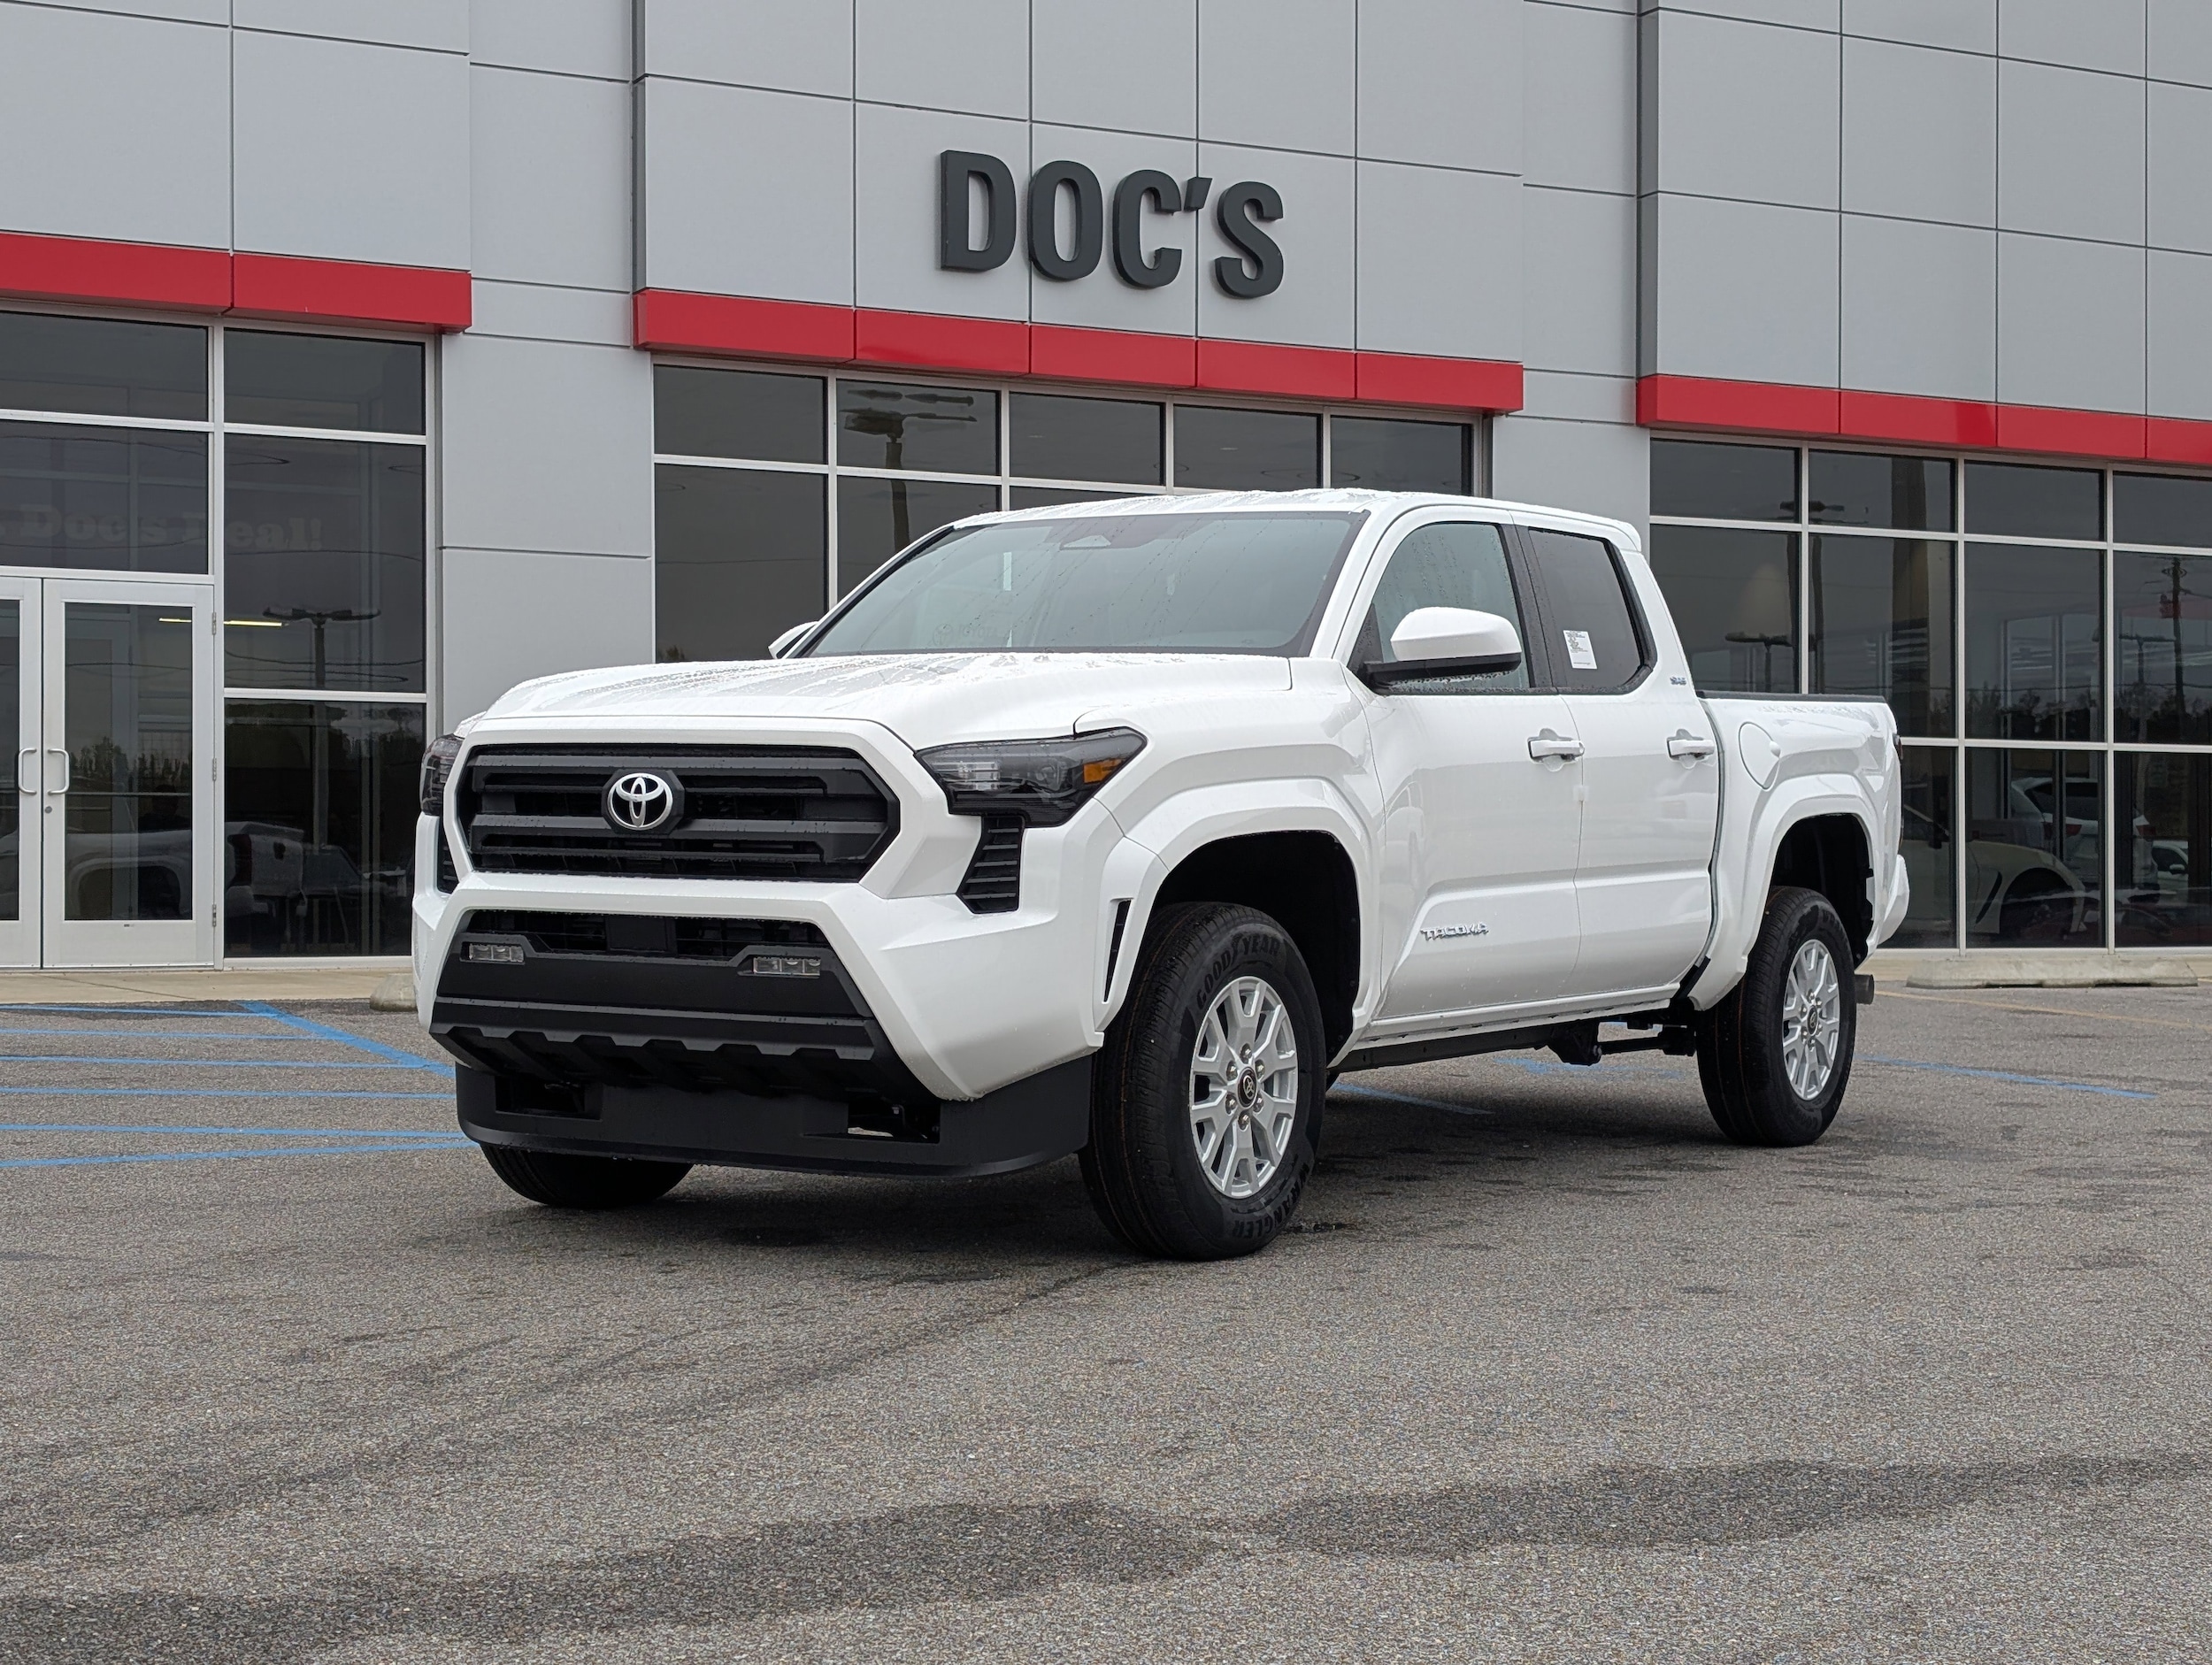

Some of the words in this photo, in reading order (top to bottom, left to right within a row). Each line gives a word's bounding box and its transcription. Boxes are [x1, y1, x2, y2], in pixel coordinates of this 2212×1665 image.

[940, 150, 1284, 298] DOC'S
[1420, 922, 1489, 941] TACOMA
[1196, 932, 1280, 1009] GOODYEAR
